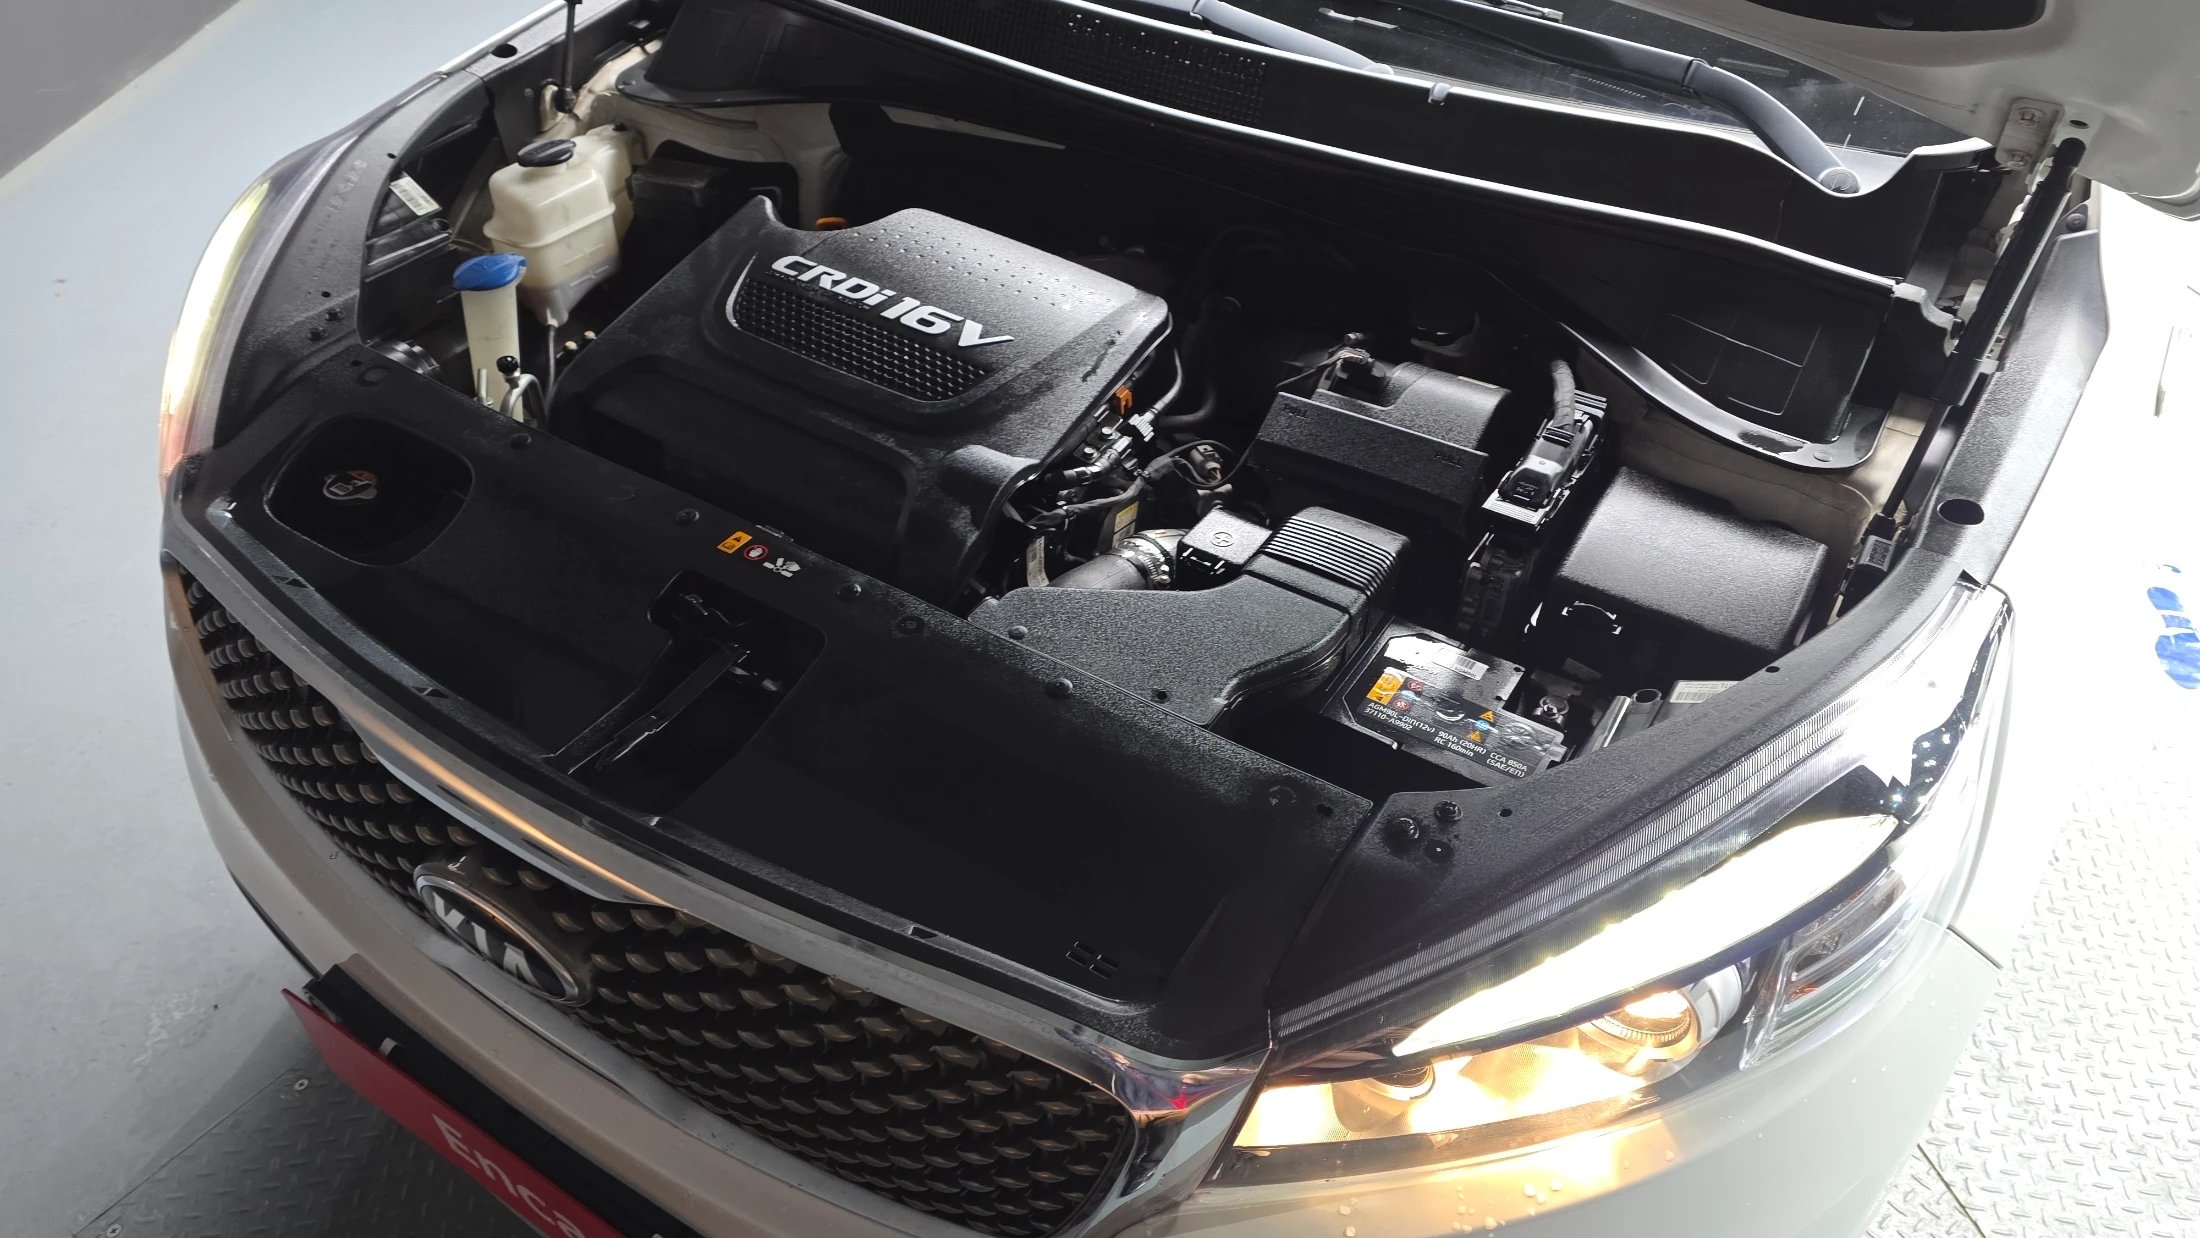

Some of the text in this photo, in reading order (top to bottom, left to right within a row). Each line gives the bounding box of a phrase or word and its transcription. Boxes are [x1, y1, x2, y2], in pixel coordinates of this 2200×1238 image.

[771, 255, 1015, 347] CRDi 16V
[1433, 736, 1447, 746] RC
[1447, 741, 1475, 757] 160min
[1459, 739, 1487, 755] (20HR)
[1489, 752, 1506, 764] CCA
[1507, 759, 1528, 772] 850A
